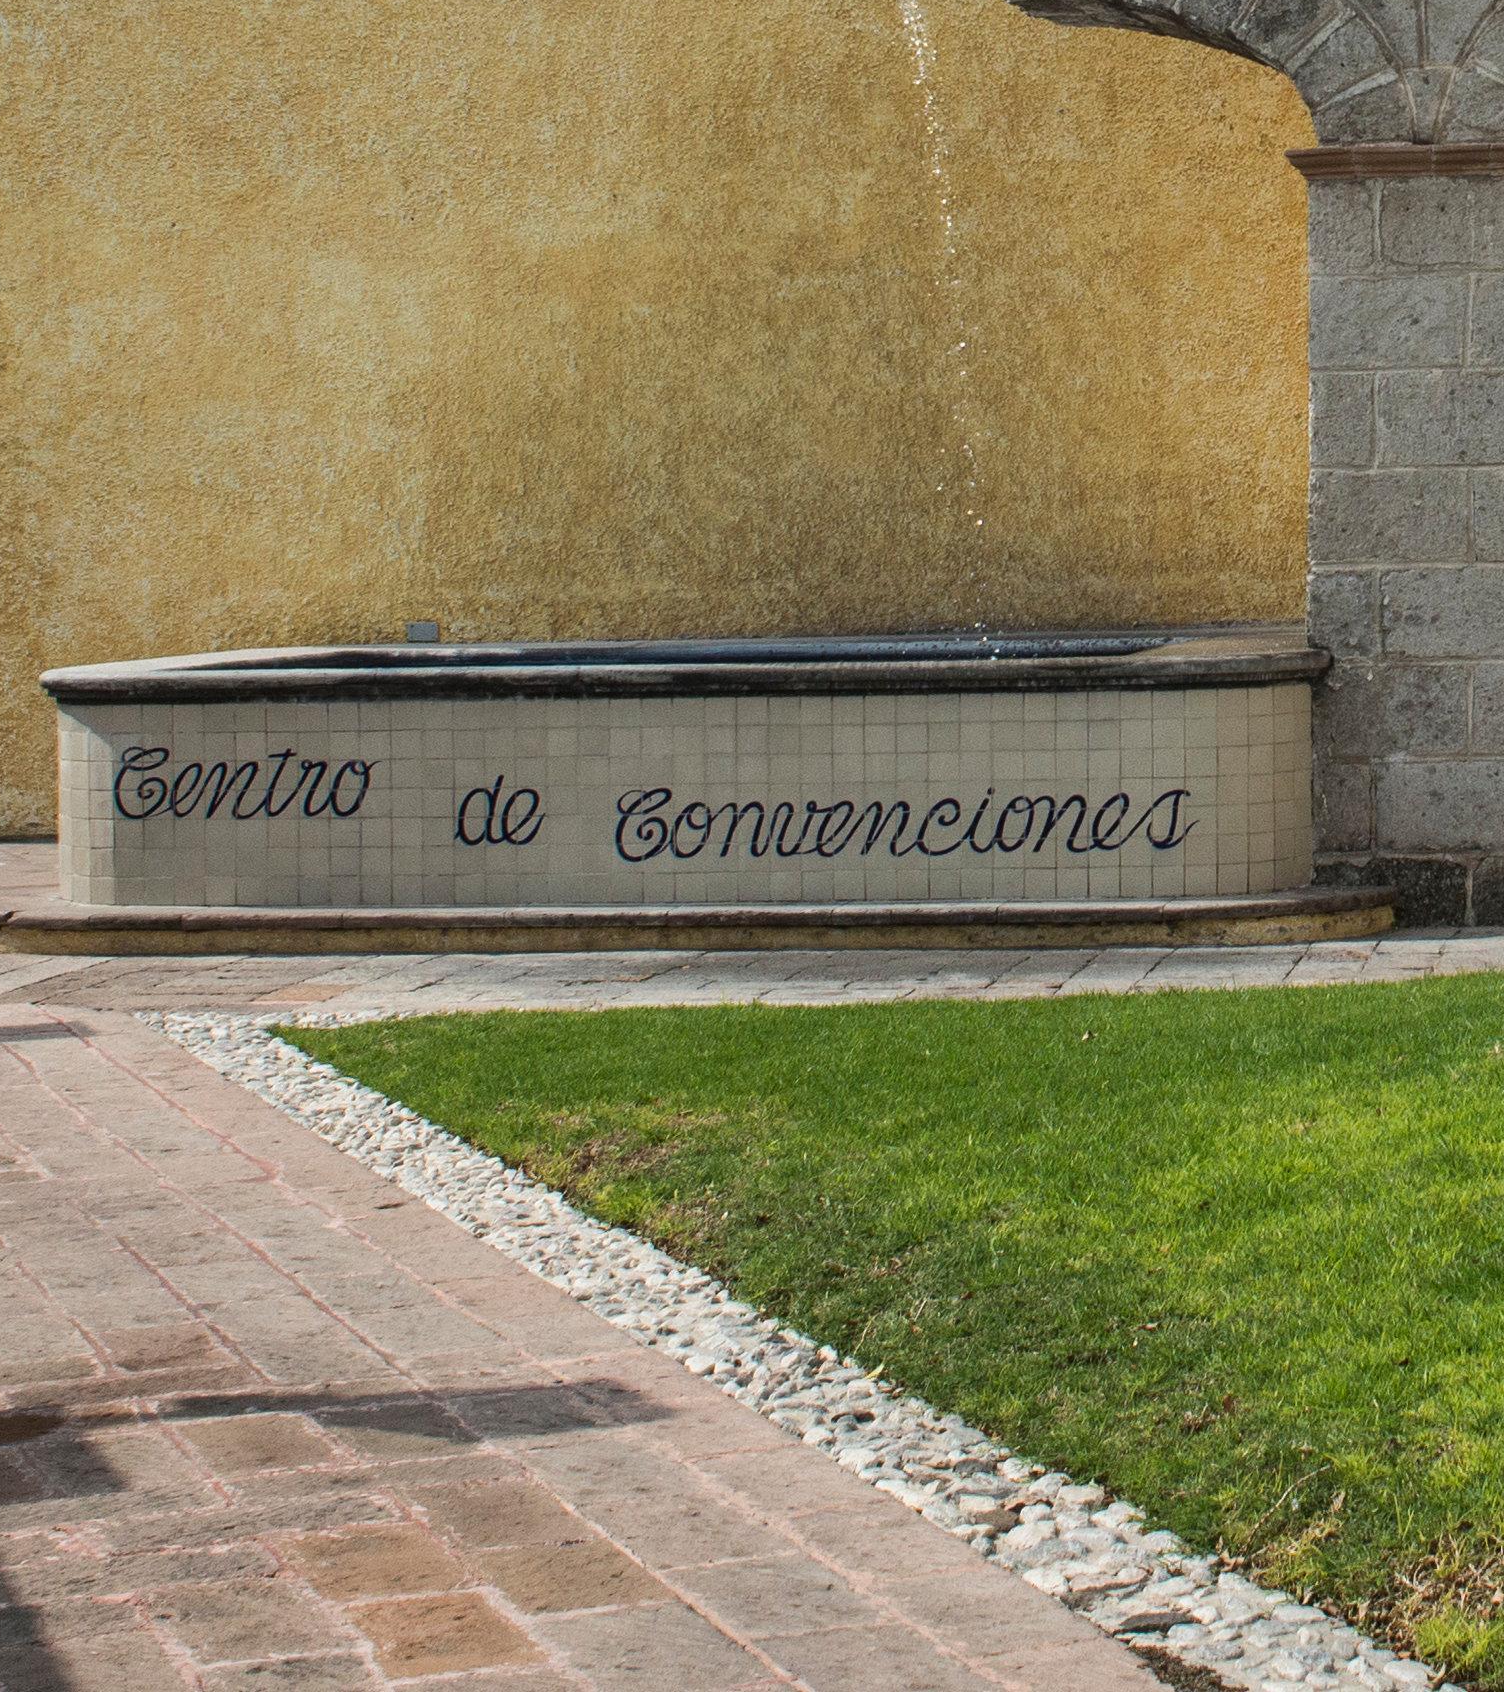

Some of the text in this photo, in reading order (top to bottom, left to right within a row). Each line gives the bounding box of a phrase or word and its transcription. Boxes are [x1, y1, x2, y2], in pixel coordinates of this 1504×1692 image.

[114, 745, 1200, 863] Centro de Convenciones
